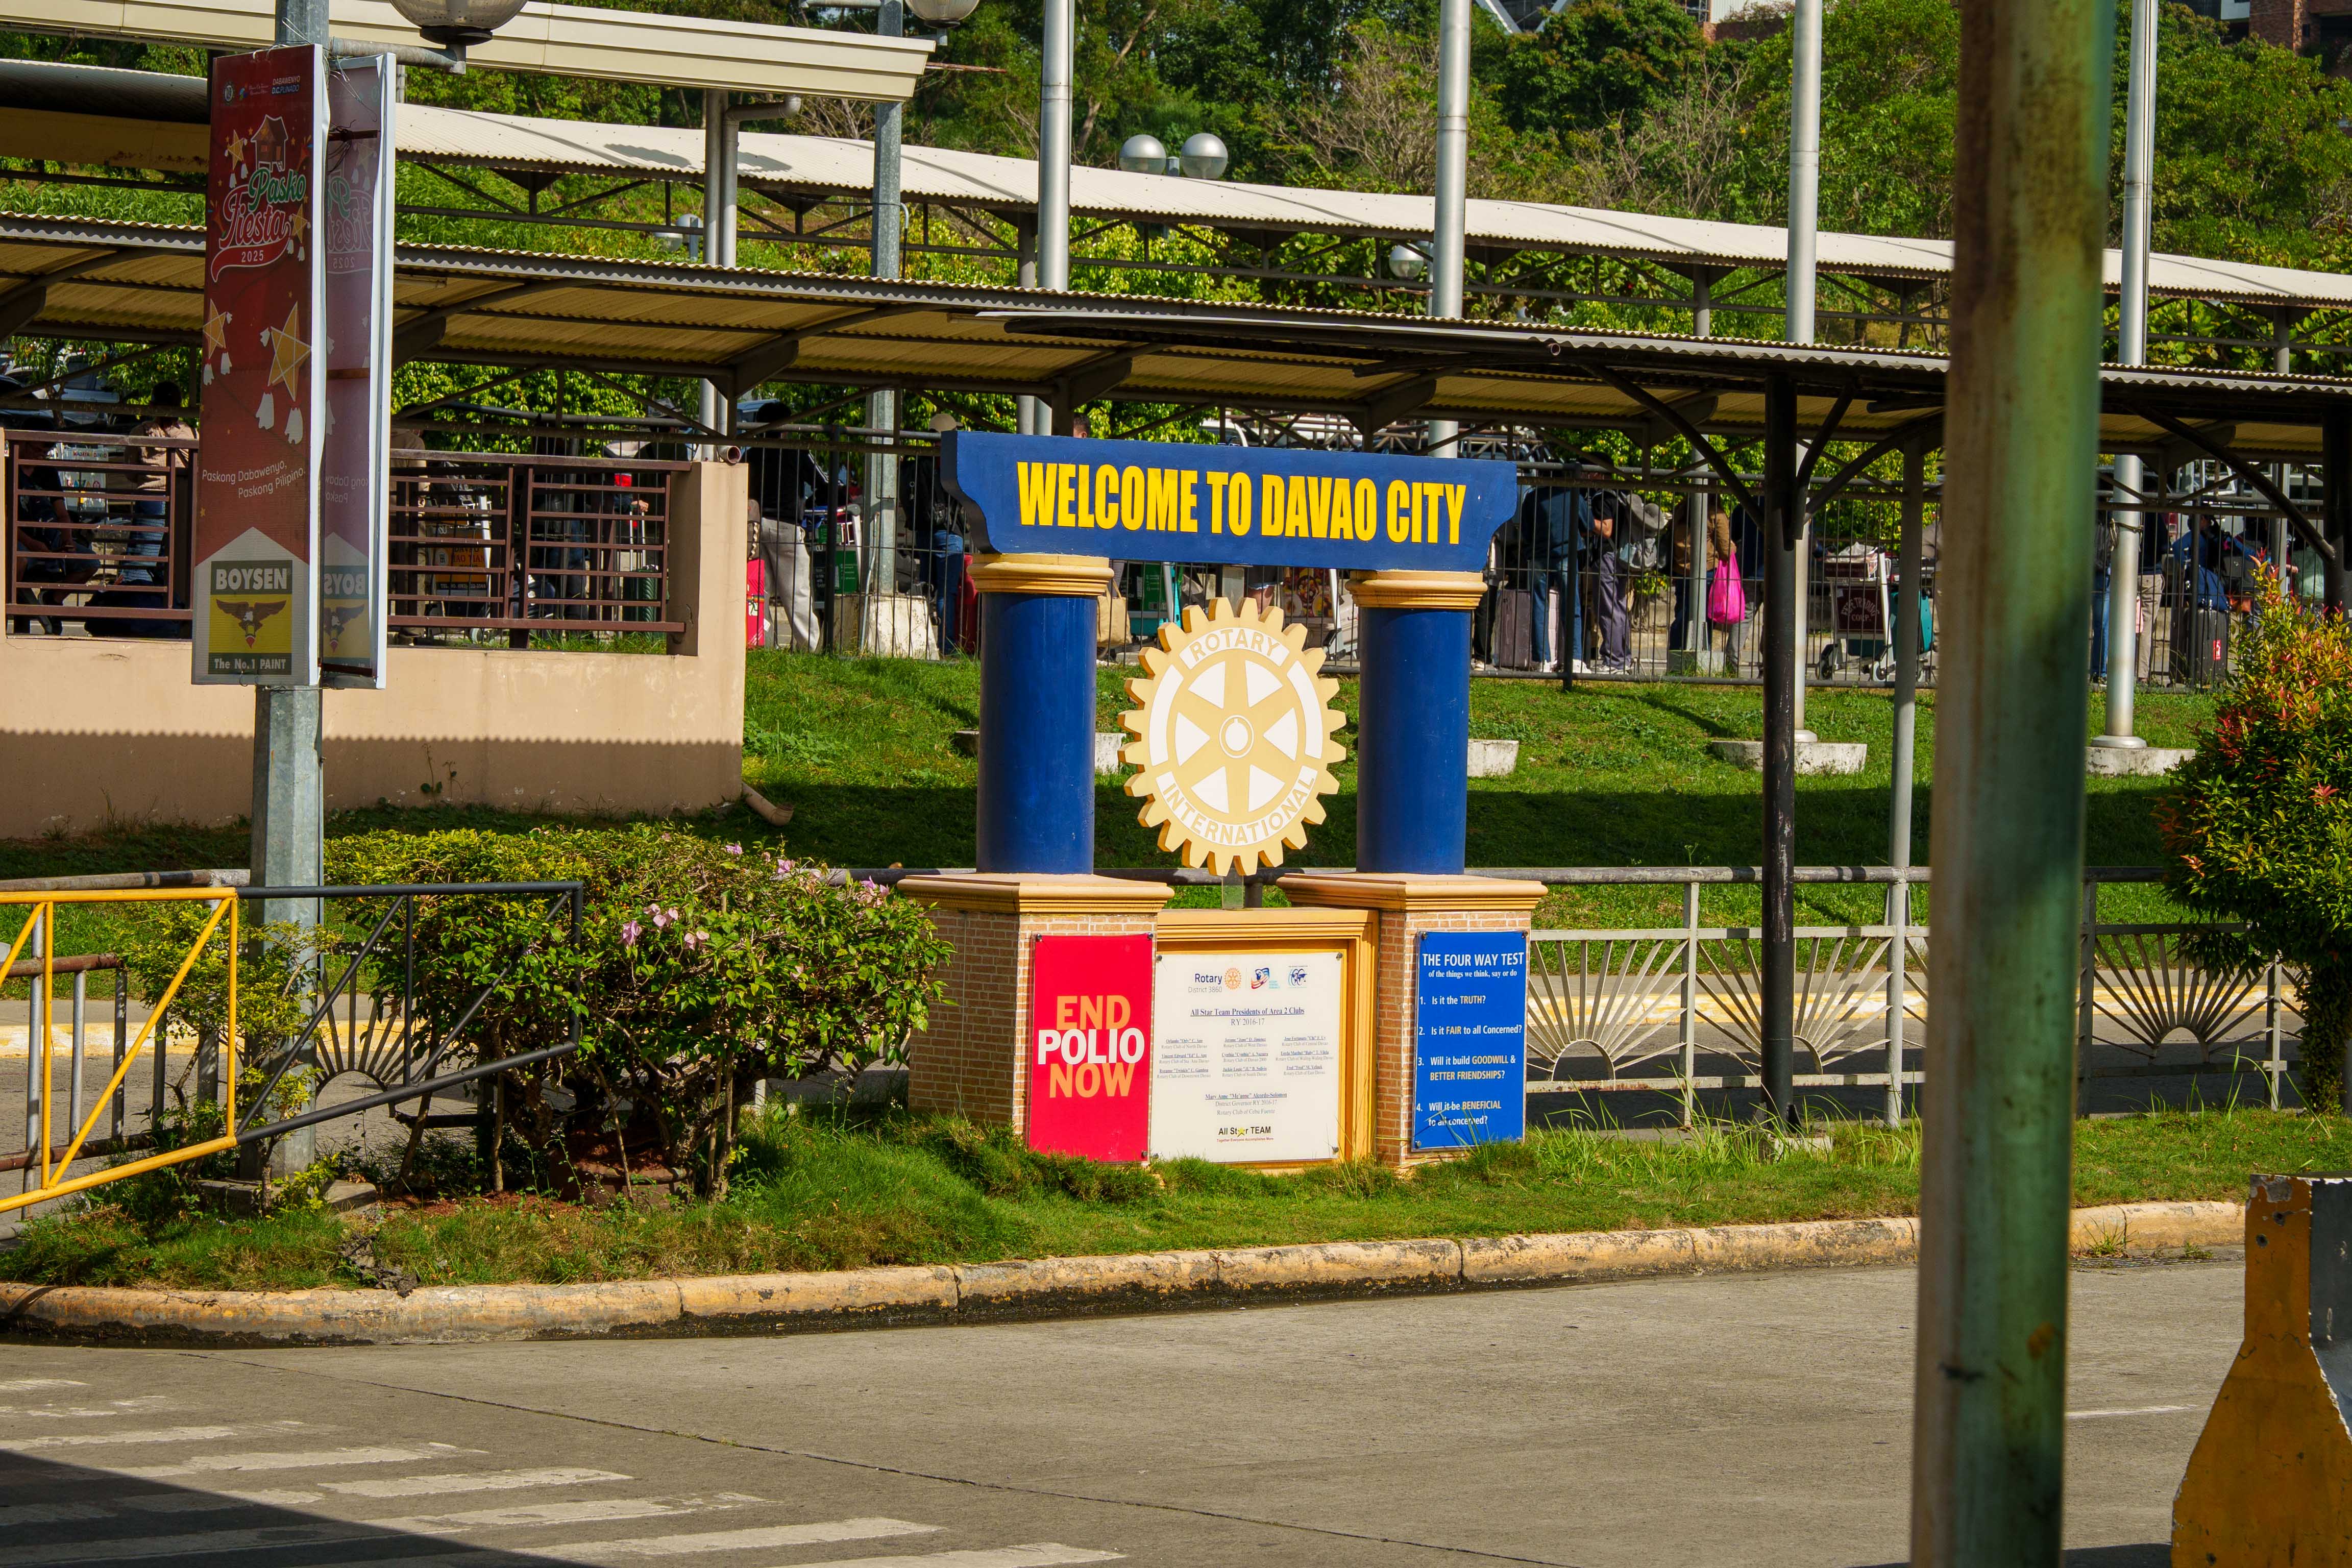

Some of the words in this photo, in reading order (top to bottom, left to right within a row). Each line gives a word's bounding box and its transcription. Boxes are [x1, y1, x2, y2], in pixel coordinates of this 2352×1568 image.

[273, 76, 300, 85] DABAWENYO
[249, 167, 306, 212] Pasko
[219, 185, 291, 249] Fiesta
[241, 251, 264, 262] 2025
[202, 470, 236, 485] Paskong
[238, 461, 287, 481] Dabawenyo,
[238, 481, 274, 498] Paskong
[276, 469, 306, 490] Pilipino.
[1017, 461, 1198, 533] WELCOME
[1206, 471, 1252, 536] TO
[1261, 474, 1376, 542] DAVAO
[1387, 480, 1467, 545] CITY
[216, 568, 287, 590] BOYSEN
[1189, 629, 1280, 662] ROTARY
[214, 658, 230, 669] The
[260, 659, 286, 669] PAINT
[1163, 777, 1315, 845] INTERNATIONAL
[1423, 953, 1440, 966] THE
[1444, 953, 1471, 966] FOUR
[1475, 953, 1497, 966] WAY
[1501, 952, 1524, 965] TEST
[1195, 973, 1222, 985] Rotary
[1446, 970, 1463, 979] things
[1474, 970, 1490, 978] think,
[1491, 971, 1501, 979] say
[1420, 997, 1426, 1005] 1.
[1432, 996, 1437, 1004] Is
[1439, 996, 1445, 1004] it
[1447, 996, 1458, 1004] the
[1460, 995, 1486, 1004] TRUTH?
[1057, 995, 1131, 1030] END
[1419, 1026, 1425, 1036] 2.
[1431, 1026, 1437, 1035] Is
[1438, 1026, 1444, 1035] it
[1446, 1026, 1461, 1035] FAIR
[1473, 1025, 1481, 1034] all
[1483, 1024, 1522, 1034] Concerned?
[1038, 1027, 1145, 1065] POLIO
[1418, 1058, 1424, 1066] 3.
[1430, 1056, 1443, 1066] Will
[1446, 1056, 1451, 1065] it
[1453, 1056, 1470, 1065] build
[1472, 1055, 1508, 1064] GOODWILL
[1510, 1055, 1515, 1064] &
[1049, 1063, 1135, 1098] NOW
[1430, 1071, 1455, 1081] BETTER
[1457, 1070, 1505, 1080] FRIENDSHIPS?
[1416, 1103, 1423, 1112] 4.
[1429, 1101, 1442, 1111] Will
[1444, 1101, 1450, 1111] it
[1452, 1101, 1460, 1111] be
[1462, 1100, 1501, 1110] BENEFICIAL
[1429, 1117, 1436, 1126] to
[1449, 1116, 1488, 1126] concerned?
[1230, 1127, 1248, 1137] Str
